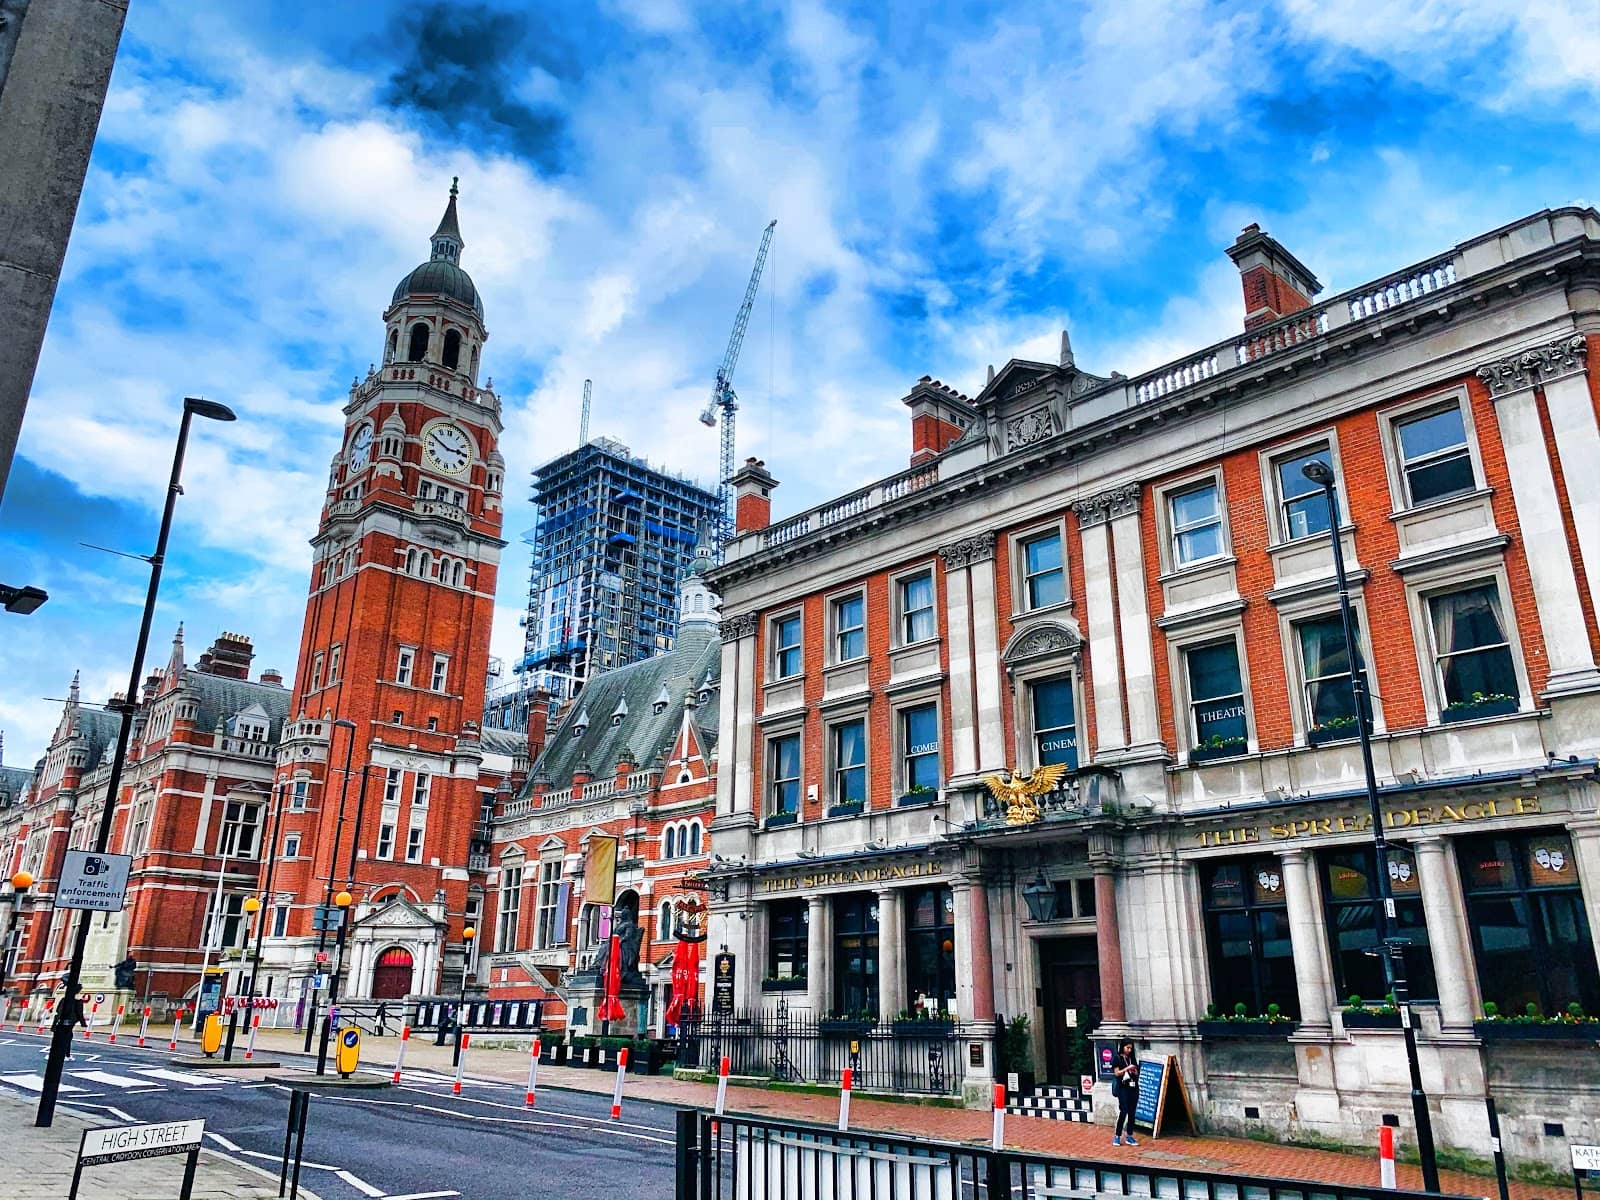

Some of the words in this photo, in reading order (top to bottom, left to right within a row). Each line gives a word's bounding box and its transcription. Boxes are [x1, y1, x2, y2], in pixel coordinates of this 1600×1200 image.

[1200, 706, 1246, 723] THEATR
[1041, 737, 1076, 752] CINEM
[1195, 826, 1259, 848] THE
[78, 878, 109, 889] Traffic
[764, 878, 799, 892] THE
[61, 887, 121, 899] enforcement
[68, 898, 110, 907] cameras
[101, 1128, 140, 1151] HIGH
[141, 1124, 189, 1146] STREET
